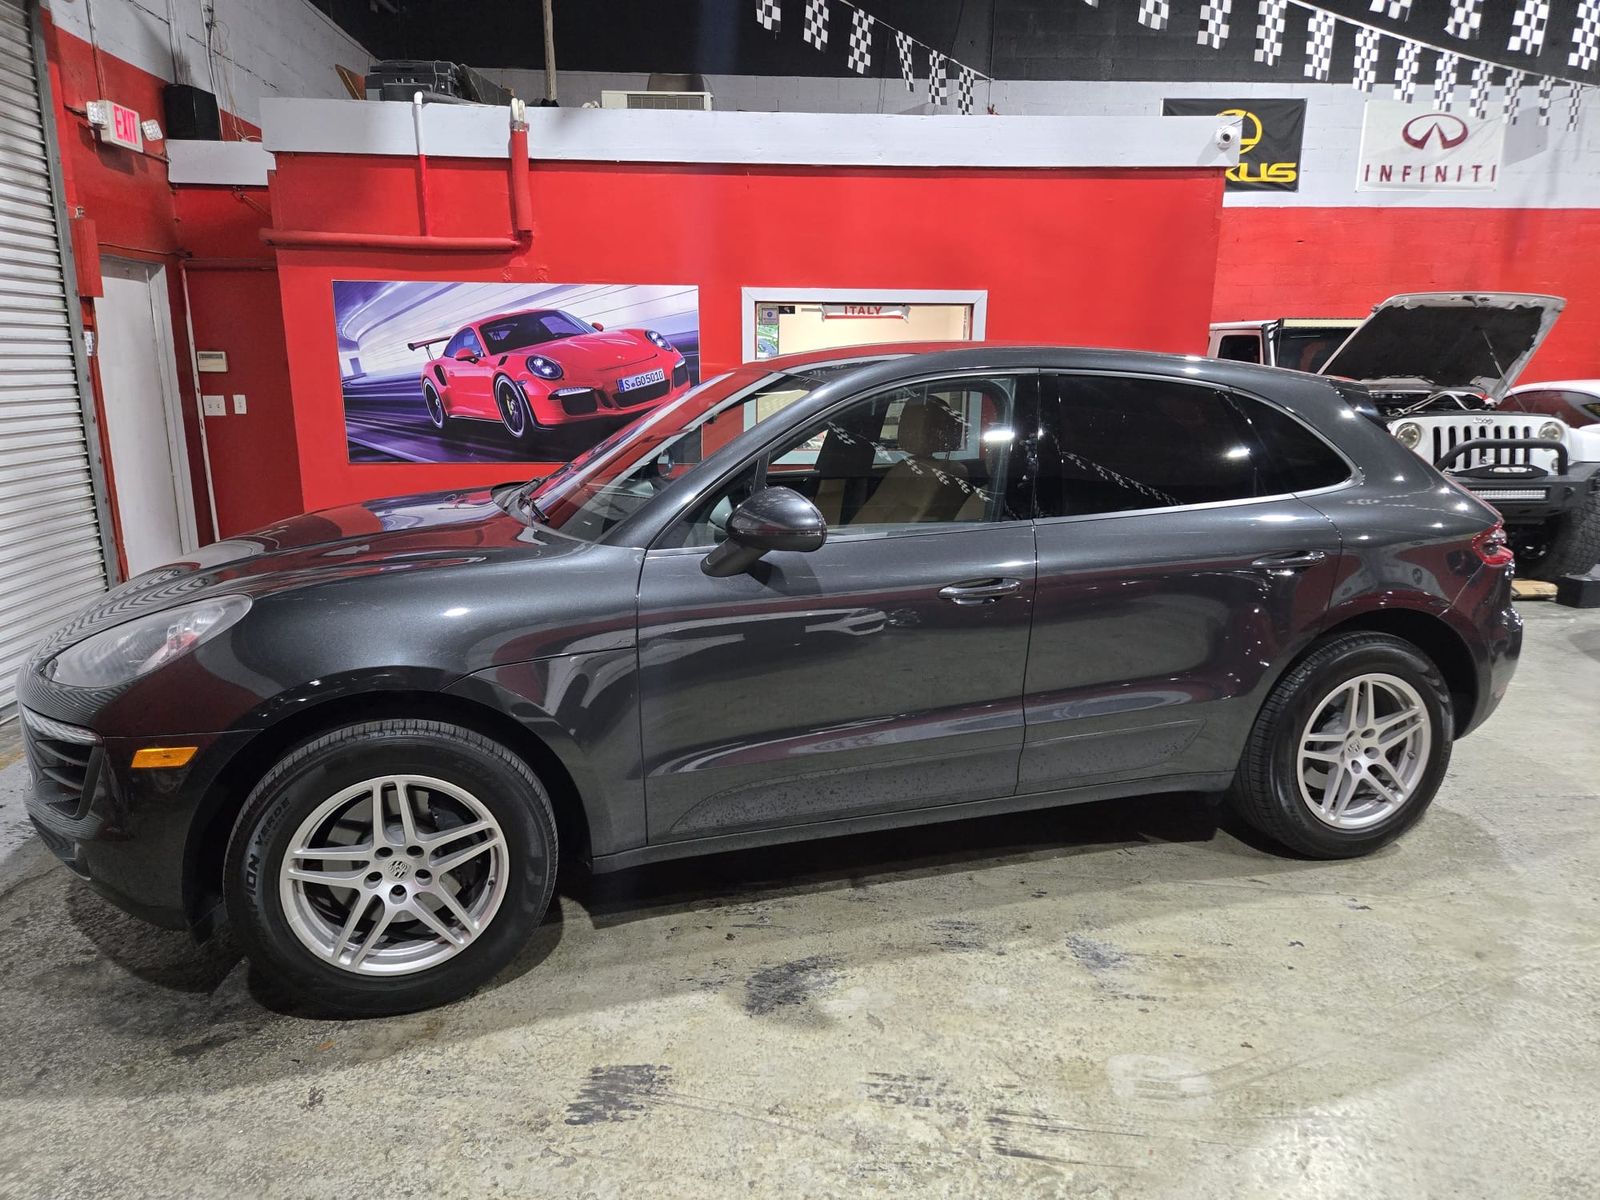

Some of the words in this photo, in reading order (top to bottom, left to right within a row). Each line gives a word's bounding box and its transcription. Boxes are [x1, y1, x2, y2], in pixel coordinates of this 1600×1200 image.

[113, 104, 138, 145] EXIT
[1364, 164, 1497, 182] INFINITI
[844, 305, 883, 315] ITALY
